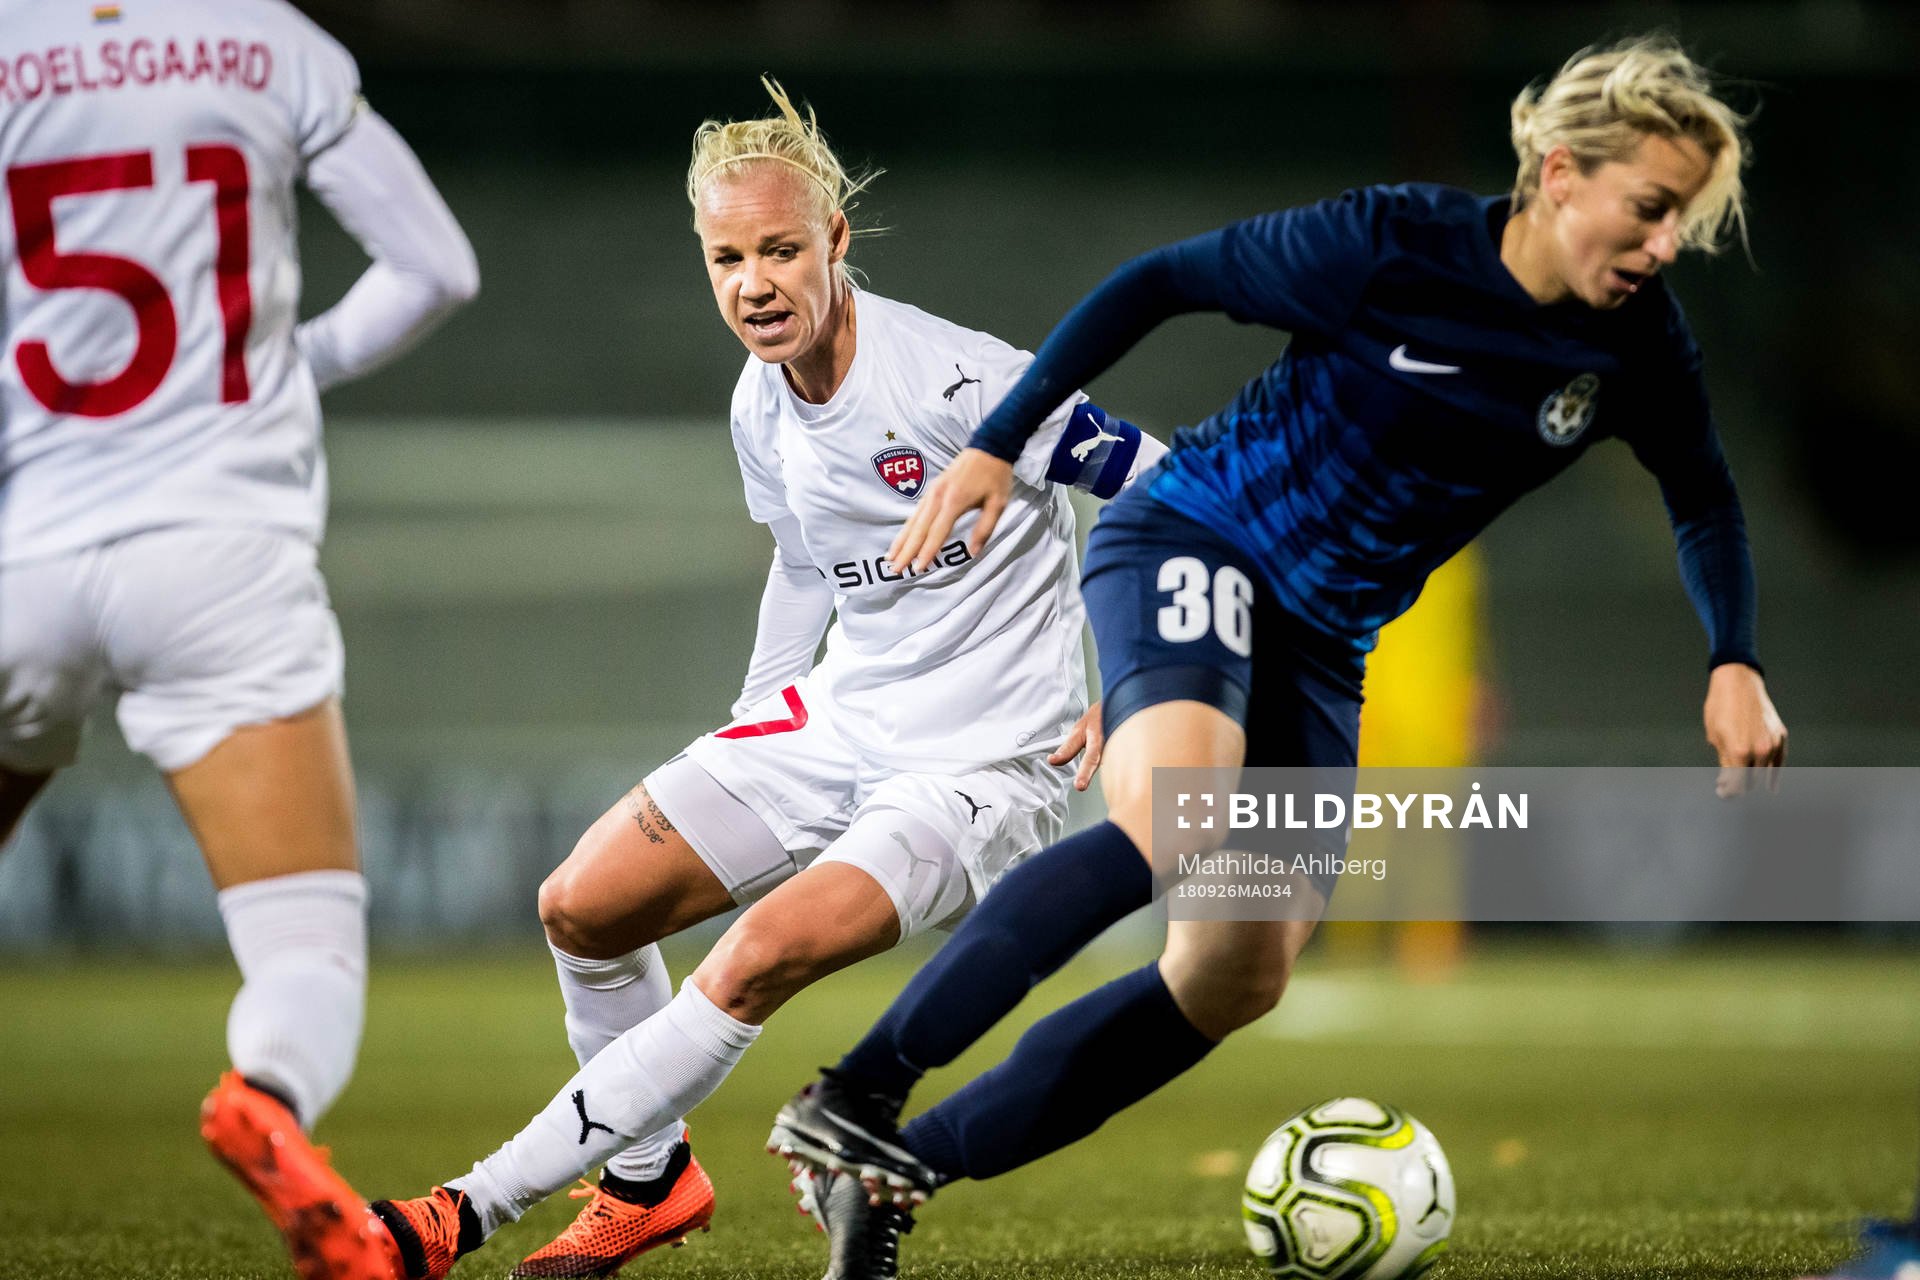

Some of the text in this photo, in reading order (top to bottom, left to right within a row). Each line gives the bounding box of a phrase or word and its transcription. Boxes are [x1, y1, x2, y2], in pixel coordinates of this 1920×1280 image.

[7, 142, 250, 419] 51
[883, 457, 919, 477] FCR
[1157, 556, 1254, 658] 36
[714, 685, 809, 740] 7
